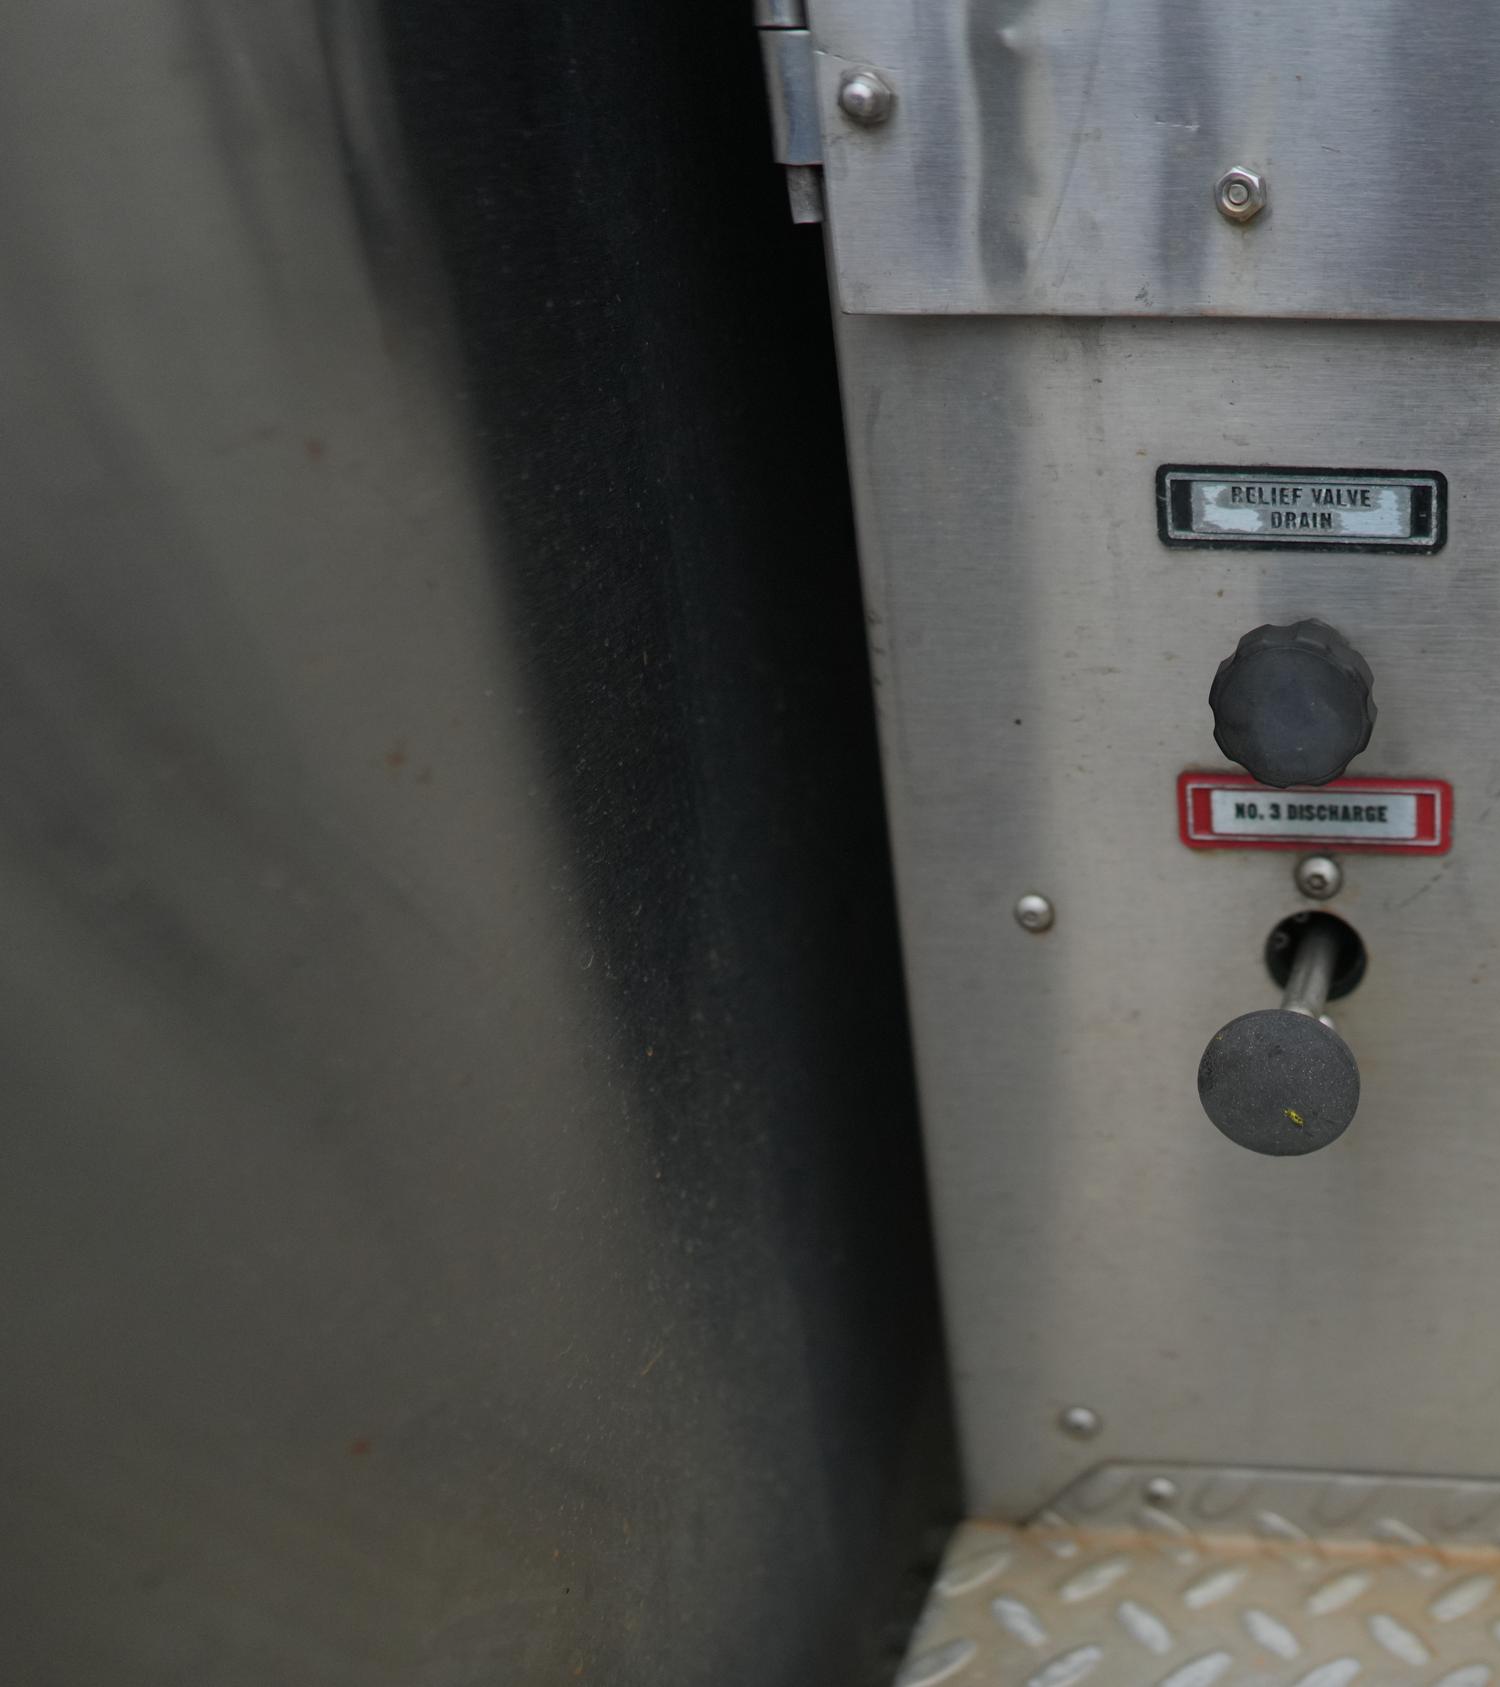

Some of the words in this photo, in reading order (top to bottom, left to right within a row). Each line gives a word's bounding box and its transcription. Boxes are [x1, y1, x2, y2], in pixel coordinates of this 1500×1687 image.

[1231, 485, 1302, 505] RELIEF
[1311, 486, 1372, 508] VALVE
[1270, 511, 1333, 529] DRAIN
[1235, 803, 1265, 820] NO.
[1270, 804, 1281, 820] 3
[1287, 805, 1388, 823] DISCHARGE
